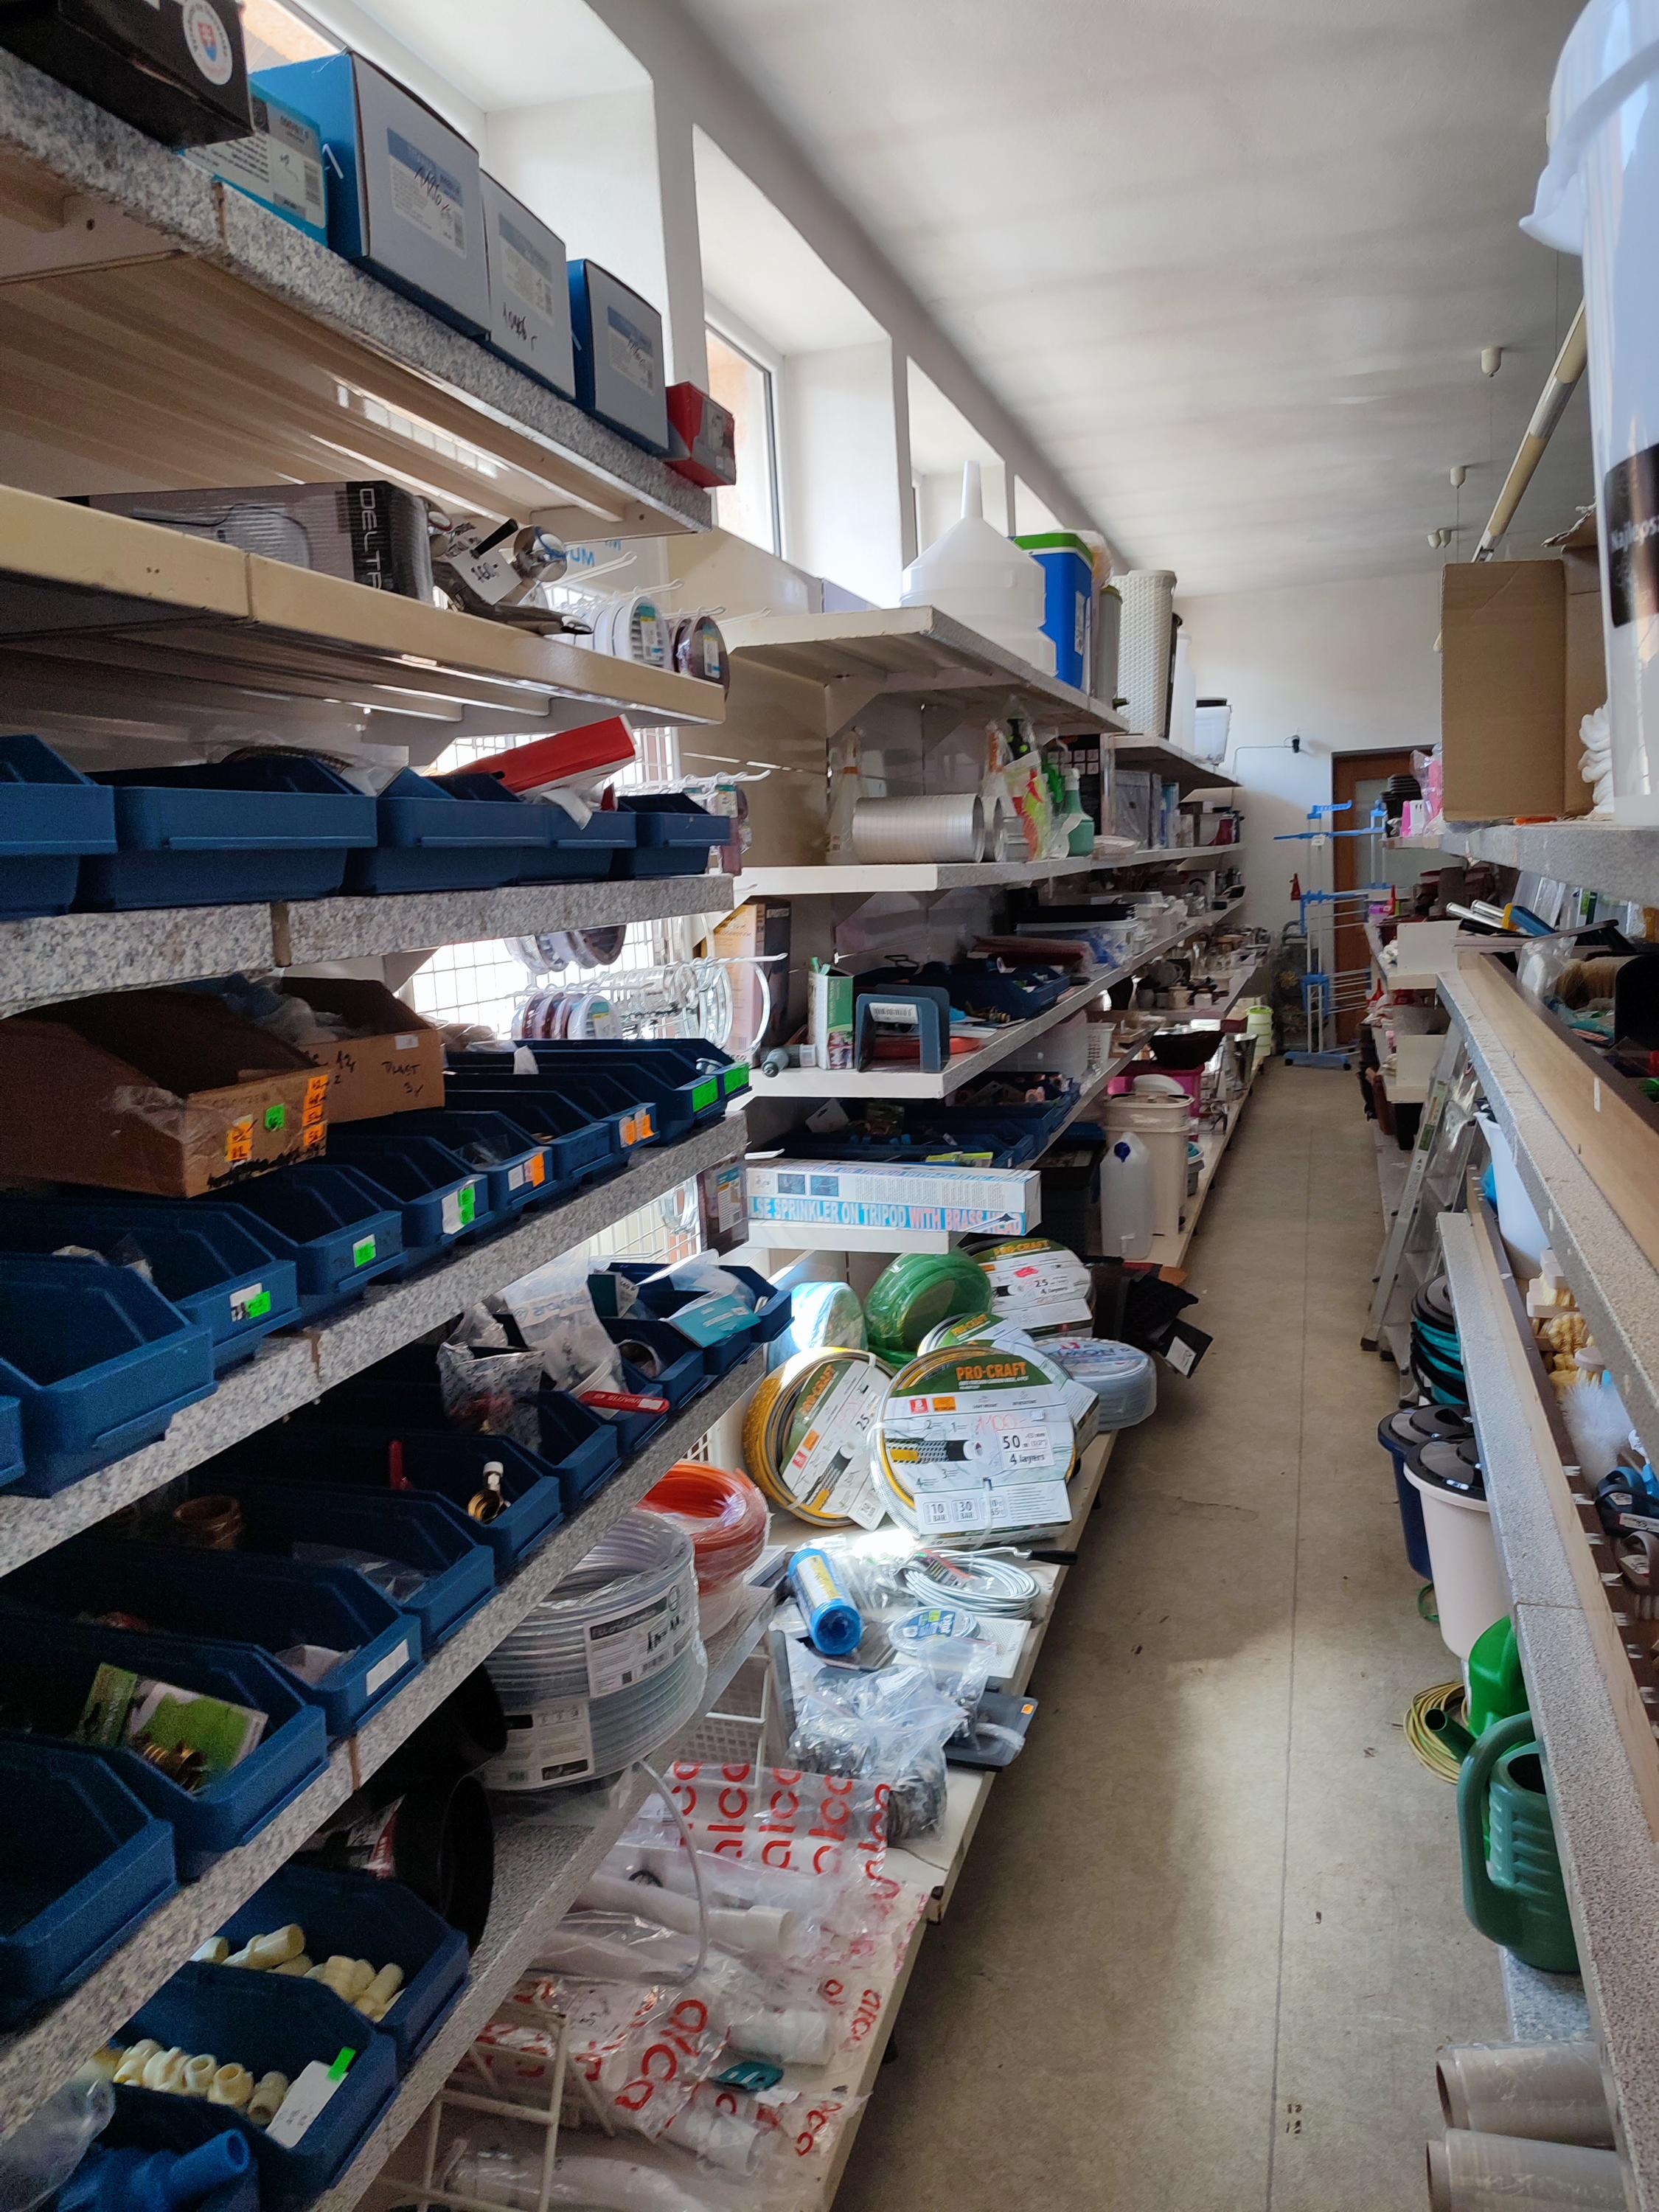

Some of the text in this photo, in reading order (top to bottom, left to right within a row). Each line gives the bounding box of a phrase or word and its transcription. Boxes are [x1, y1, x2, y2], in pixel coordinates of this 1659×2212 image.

[775, 1198, 839, 1222] SPRINKLER
[842, 1203, 860, 1225] ON
[861, 1203, 907, 1228] TRIPOD
[908, 1208, 942, 1230] WITH
[945, 1208, 984, 1232] BRASS
[956, 1362, 1027, 1380] PRO-CRAFT
[1002, 1436, 1020, 1450] 50
[1009, 1454, 1018, 1464] 4
[930, 1503, 945, 1514] 10
[959, 1501, 973, 1512] 30
